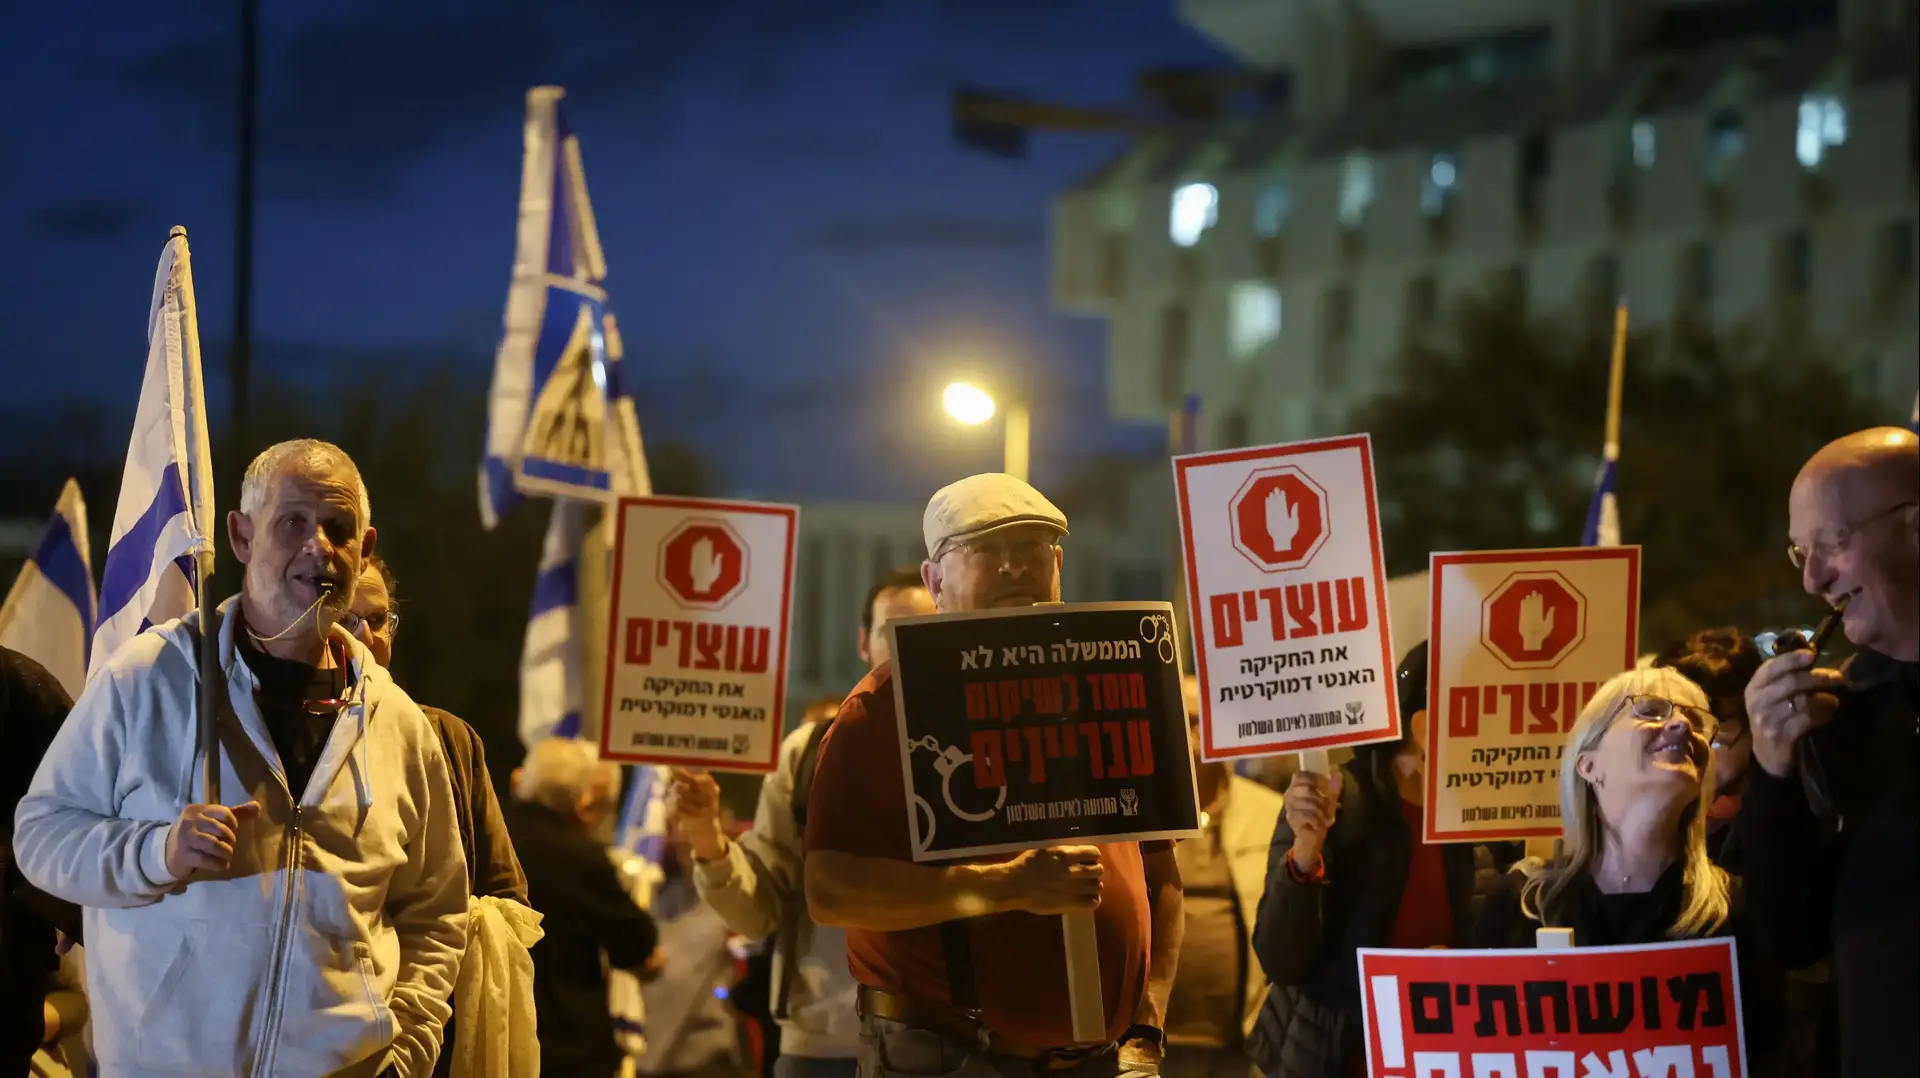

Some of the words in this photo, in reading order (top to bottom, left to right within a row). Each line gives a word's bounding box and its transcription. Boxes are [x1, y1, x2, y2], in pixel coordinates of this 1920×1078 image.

[1209, 576, 1369, 649] עוצרים
[624, 617, 771, 674] עוצרים
[1051, 638, 1142, 665] הממשלה
[1320, 645, 1349, 662] את
[960, 645, 994, 671] לא
[1001, 646, 1045, 667] היא
[1240, 650, 1315, 677] החקיקה
[643, 676, 714, 697] החקיקה
[1318, 668, 1376, 686] האנטי
[718, 682, 745, 698] את
[964, 673, 1080, 724] לשיקום
[1085, 672, 1147, 711] מוסד
[1219, 675, 1313, 703] דמוקרטית
[620, 697, 708, 720] דמוקרטית
[712, 705, 766, 722] האנטי
[1309, 710, 1342, 727] התנועה
[1238, 720, 1274, 739] השלטון
[1276, 713, 1307, 733] לאיכות
[970, 718, 1155, 789] עבריינים
[1471, 745, 1550, 766] החקיקה
[1446, 769, 1545, 789] דמוקרטית
[1006, 801, 1046, 825] השלטון
[1048, 798, 1081, 819] לאיכות
[1083, 797, 1118, 816] התנועה
[1408, 971, 1726, 1038] מושחתים
